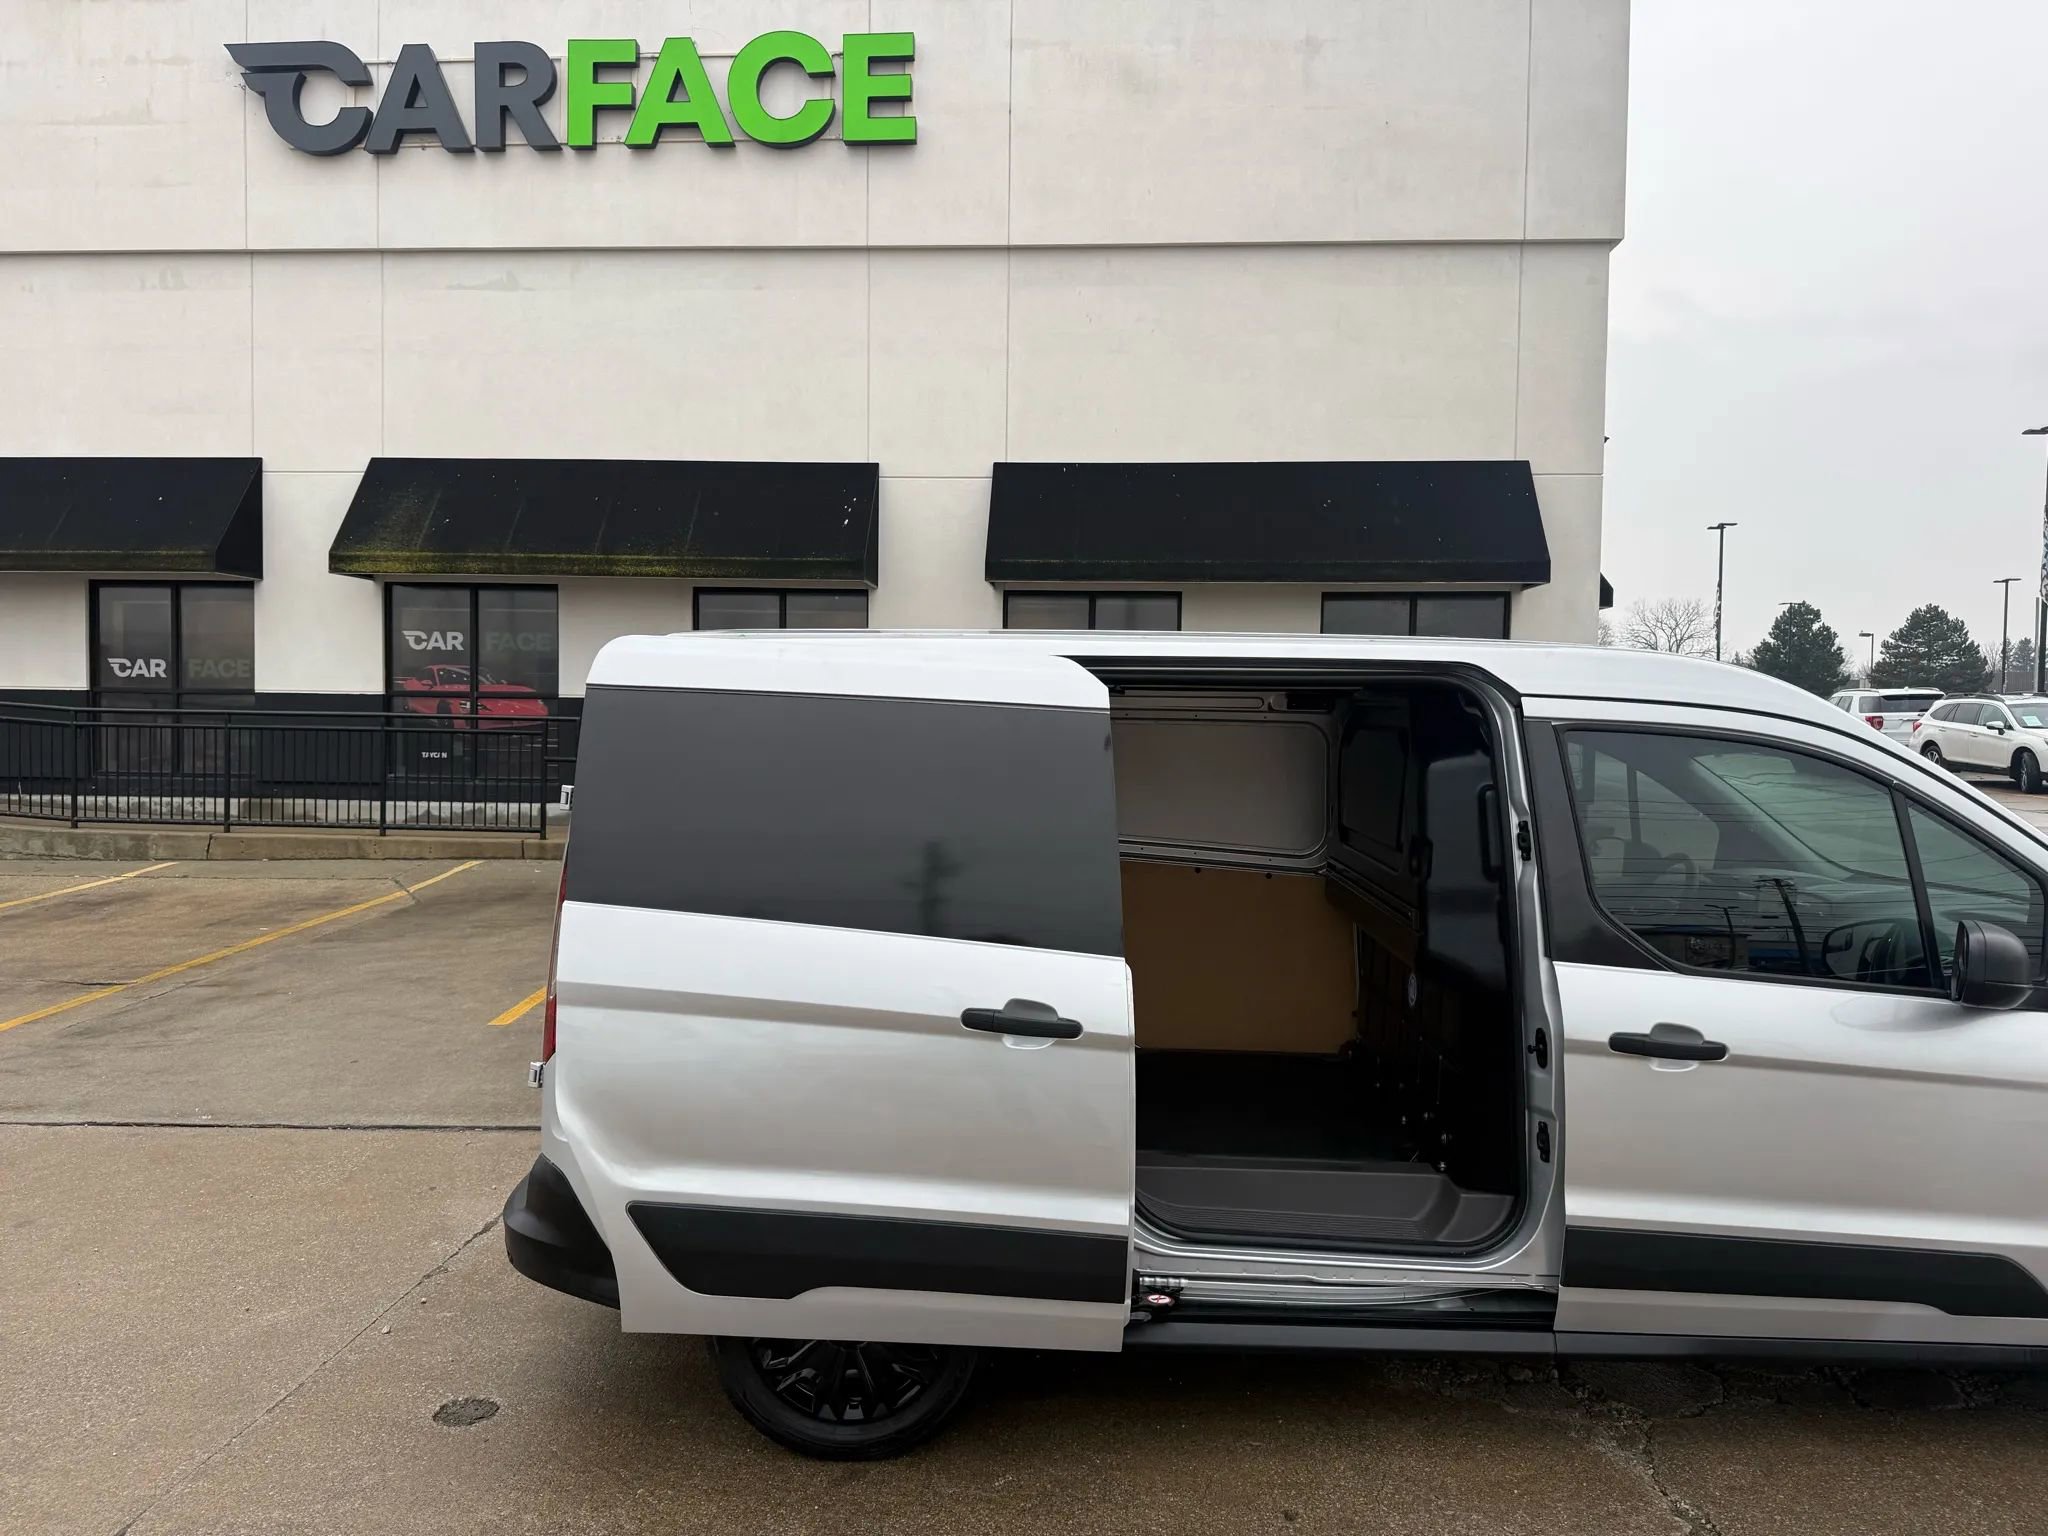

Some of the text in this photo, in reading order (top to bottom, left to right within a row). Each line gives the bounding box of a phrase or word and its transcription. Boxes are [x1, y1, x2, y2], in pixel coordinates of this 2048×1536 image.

[401, 630, 554, 652] CAR FACE
[106, 657, 252, 679] CAR FACE
